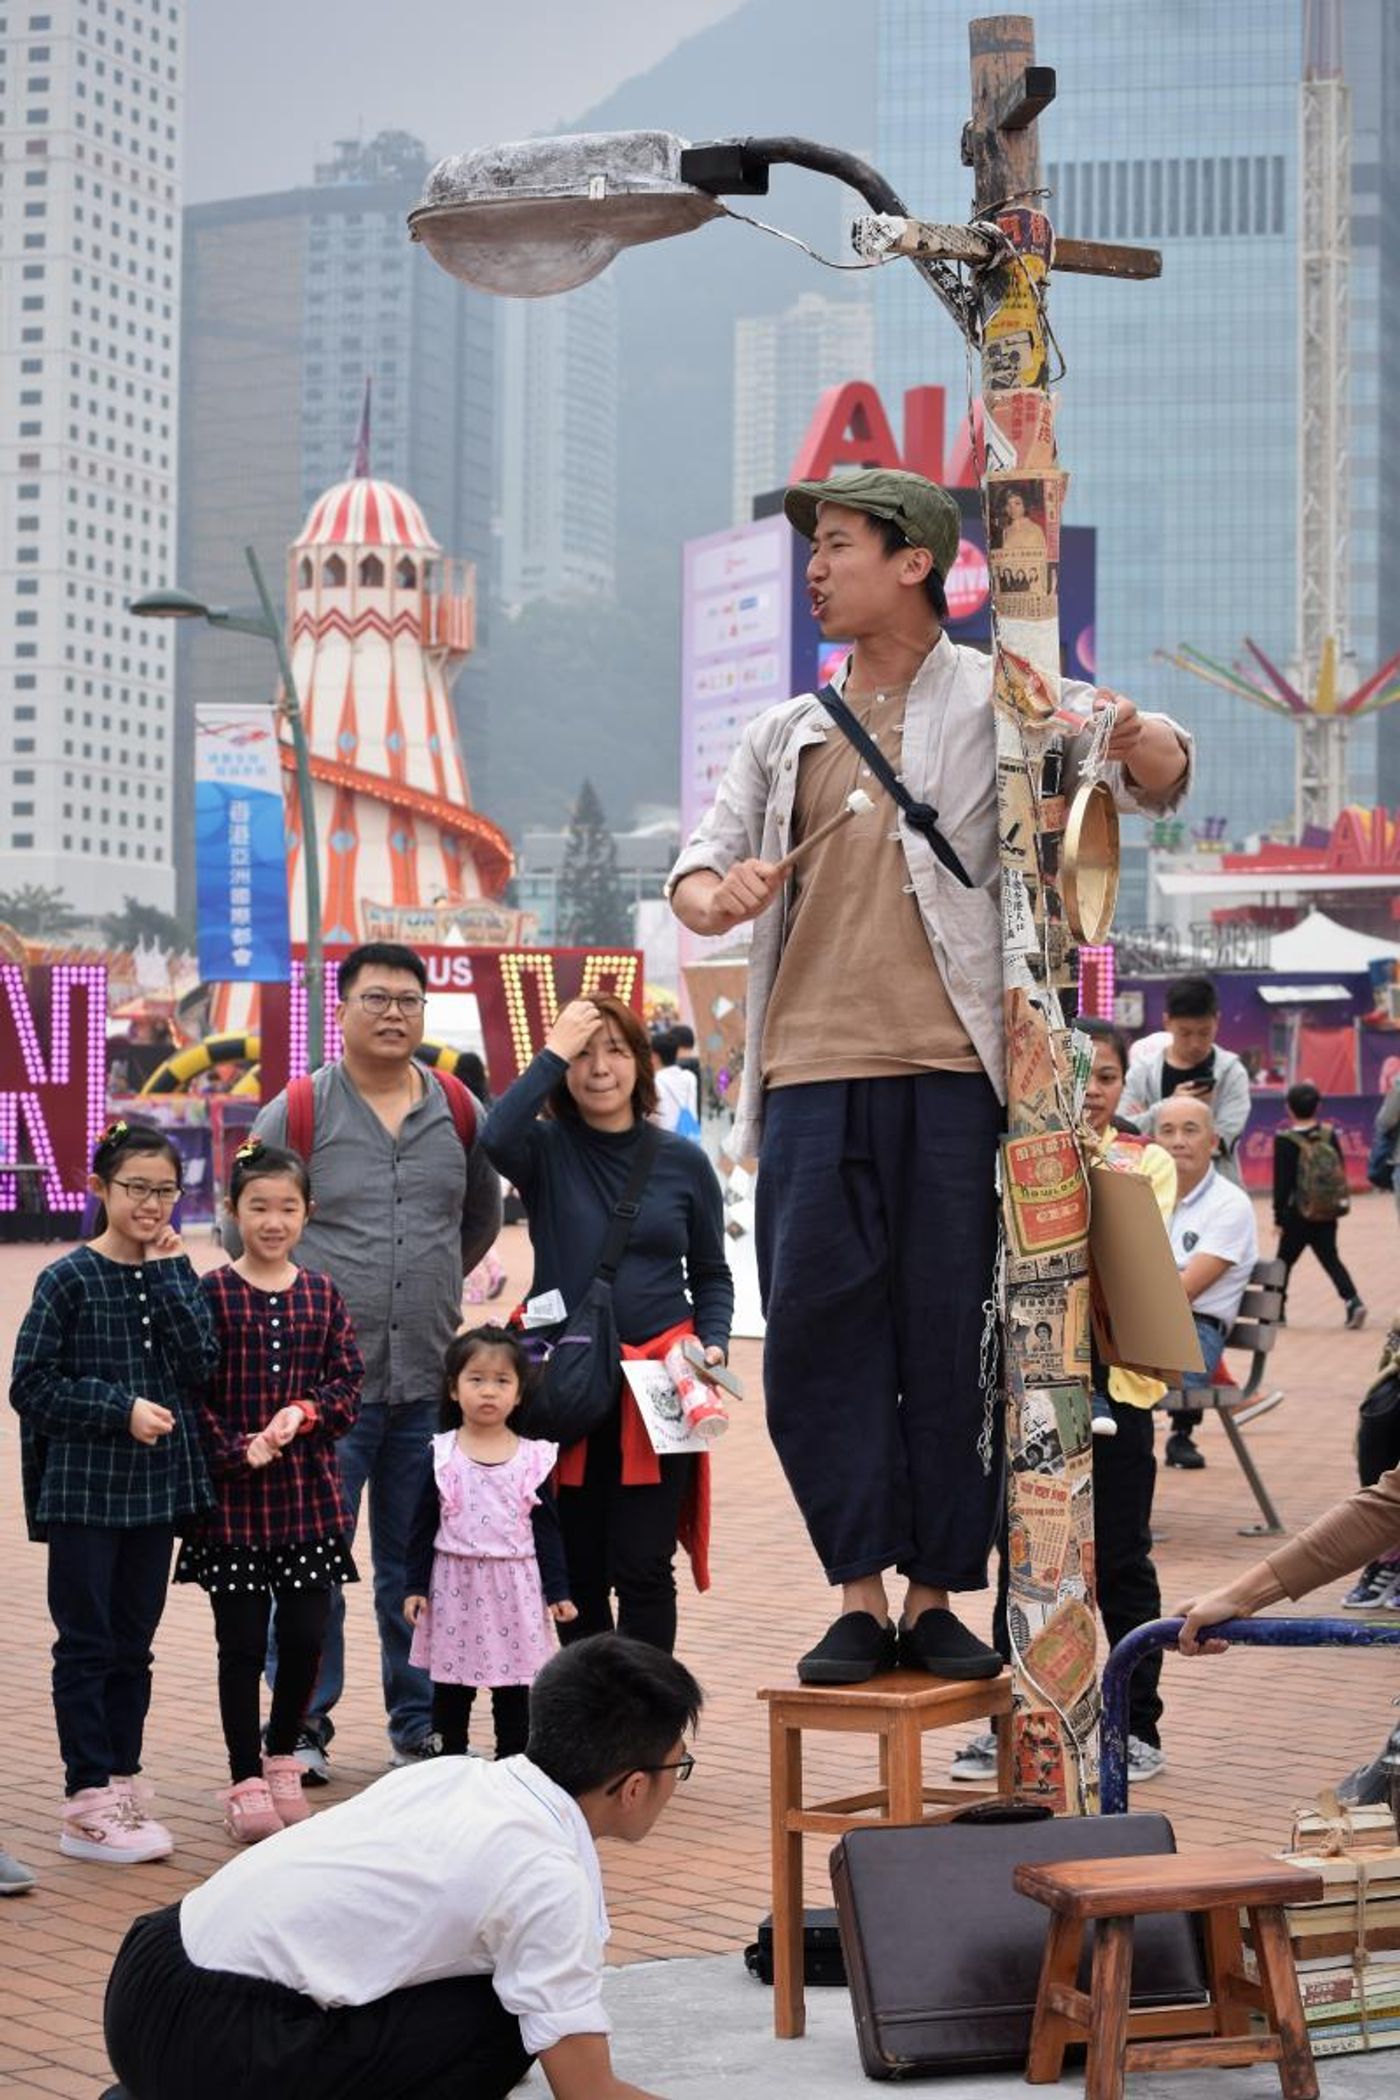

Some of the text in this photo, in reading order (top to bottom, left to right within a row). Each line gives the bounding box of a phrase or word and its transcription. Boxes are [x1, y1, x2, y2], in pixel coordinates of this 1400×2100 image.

[789, 380, 985, 488] AI
[1330, 803, 1400, 868] AI
[229, 800, 252, 967] 香港亞洲國際都會
[419, 954, 473, 987] US
